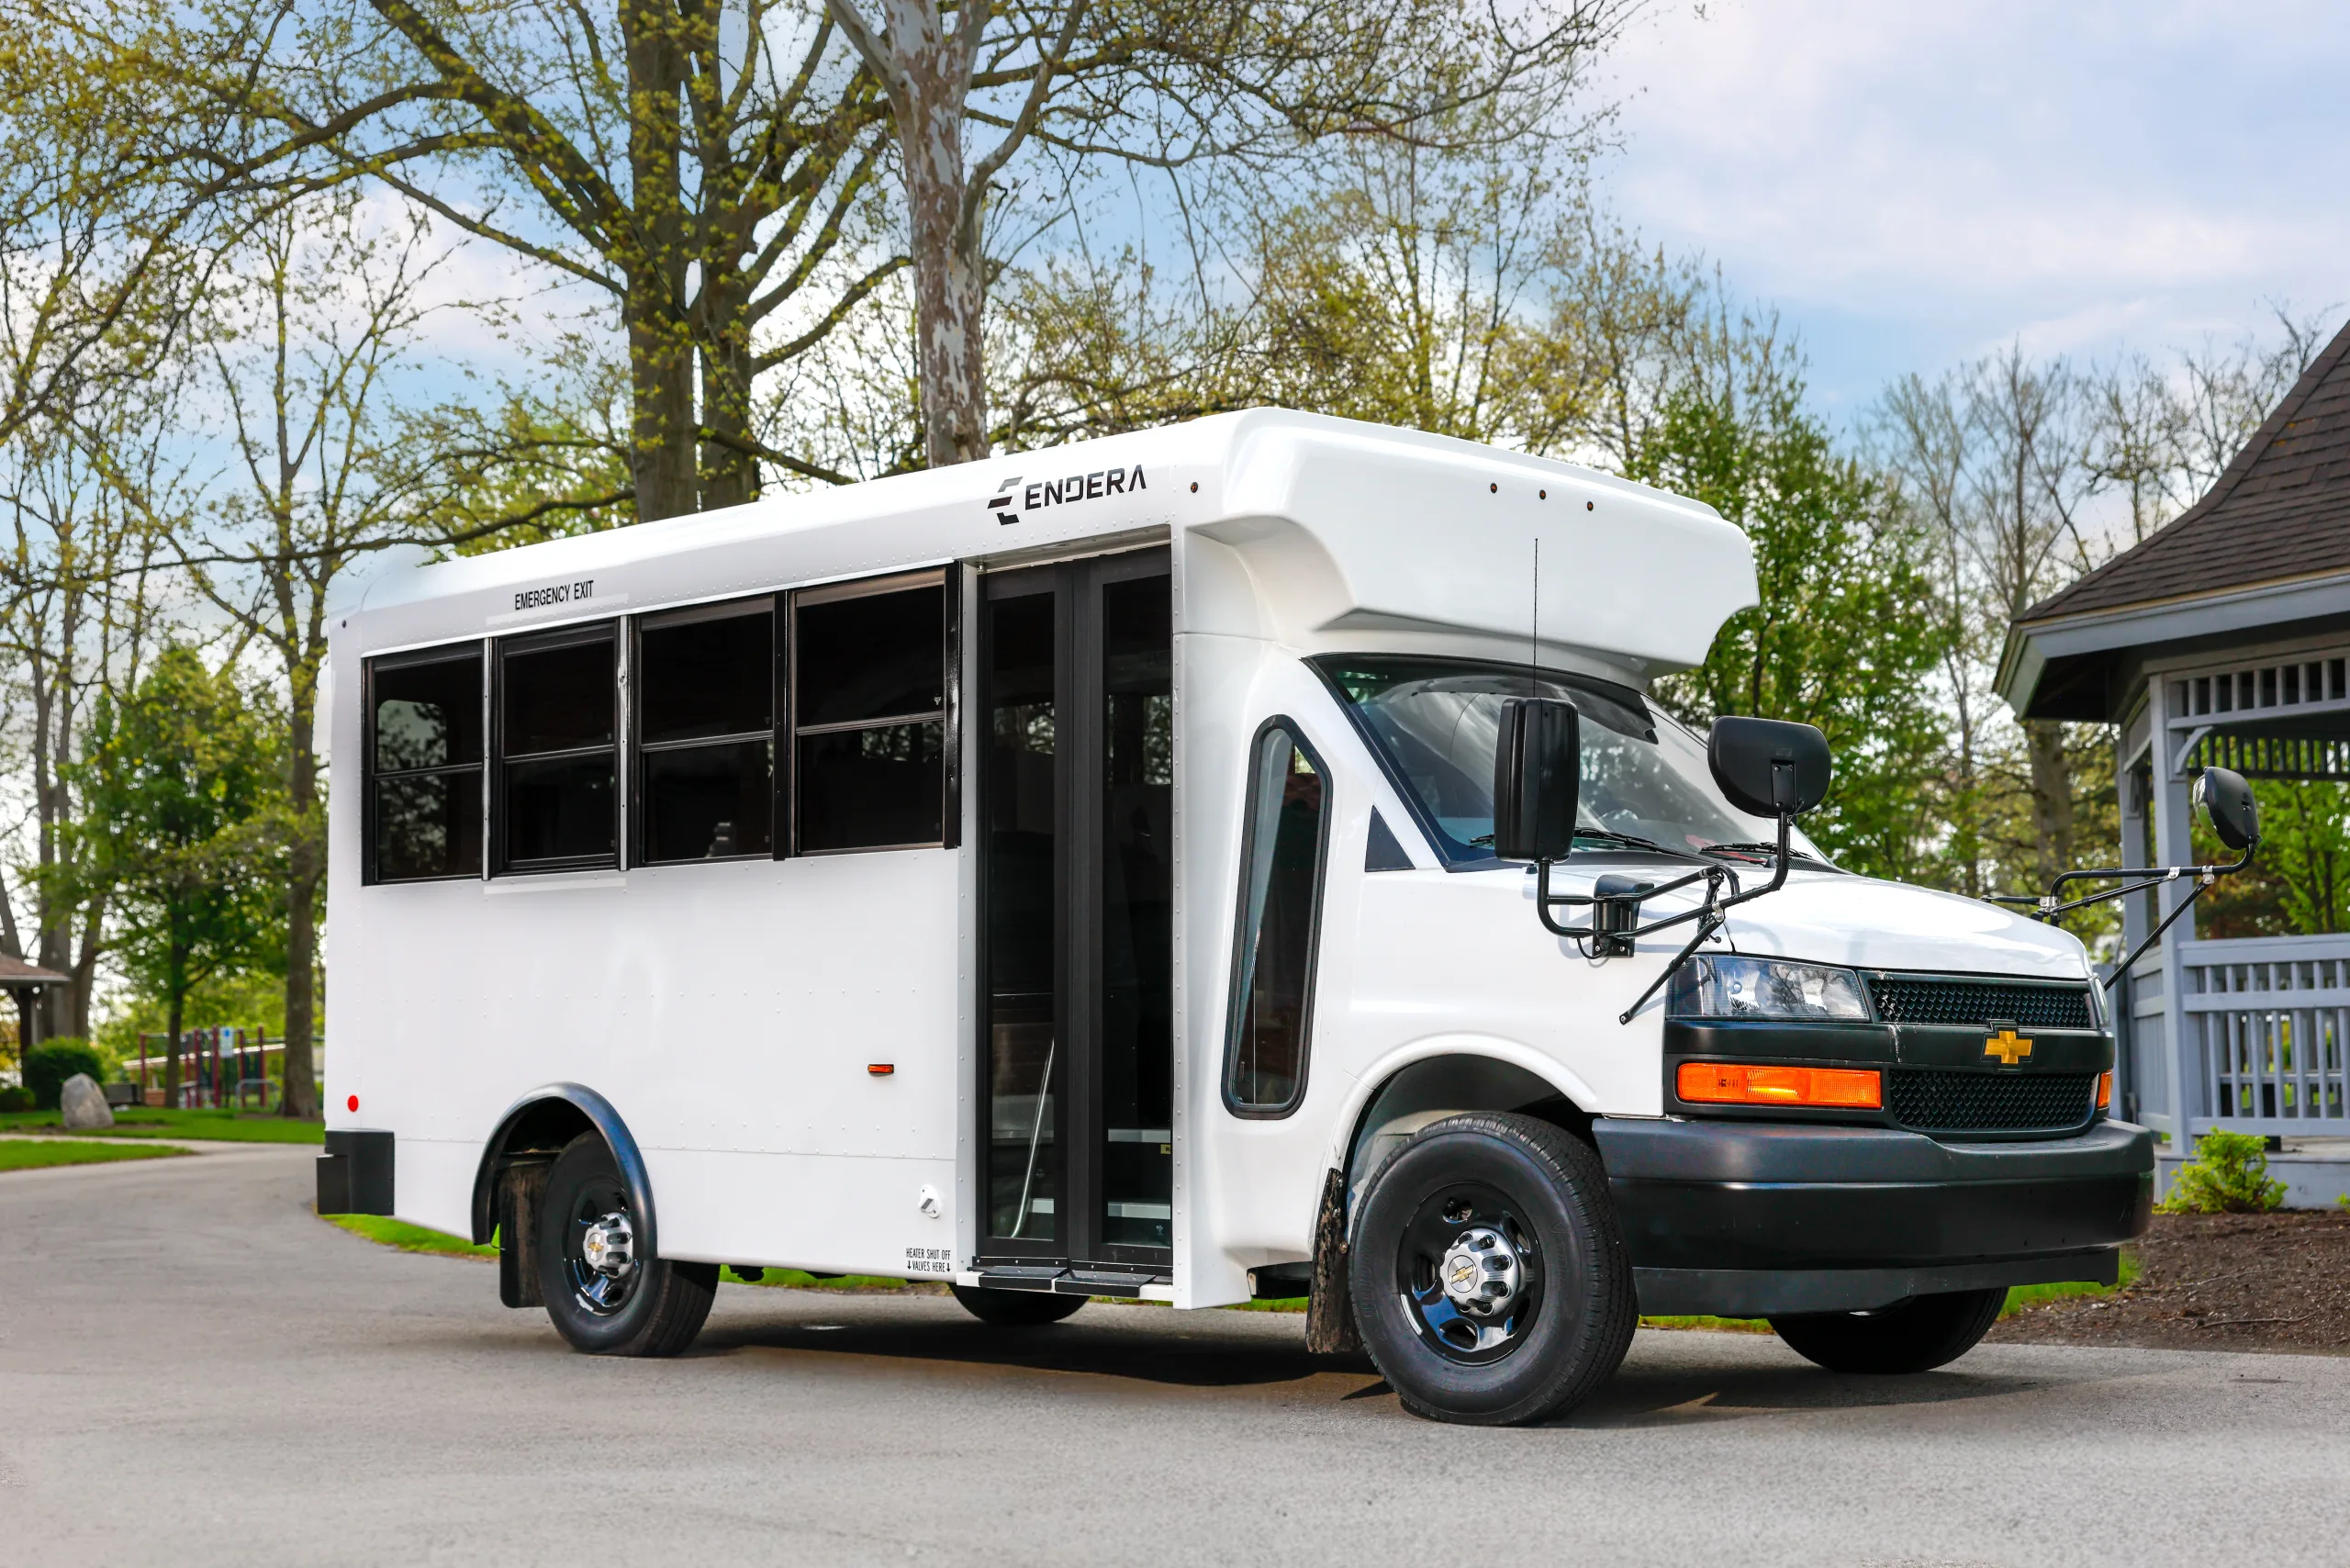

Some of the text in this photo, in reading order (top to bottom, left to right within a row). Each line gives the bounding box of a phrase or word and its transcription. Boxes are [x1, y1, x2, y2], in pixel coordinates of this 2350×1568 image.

[1024, 464, 1147, 510] ENDERA
[515, 580, 594, 610] EMERGENCY EXIT
[906, 1248, 951, 1260] HEATER SHUT OFF
[912, 1260, 946, 1272] VALVES HERE
